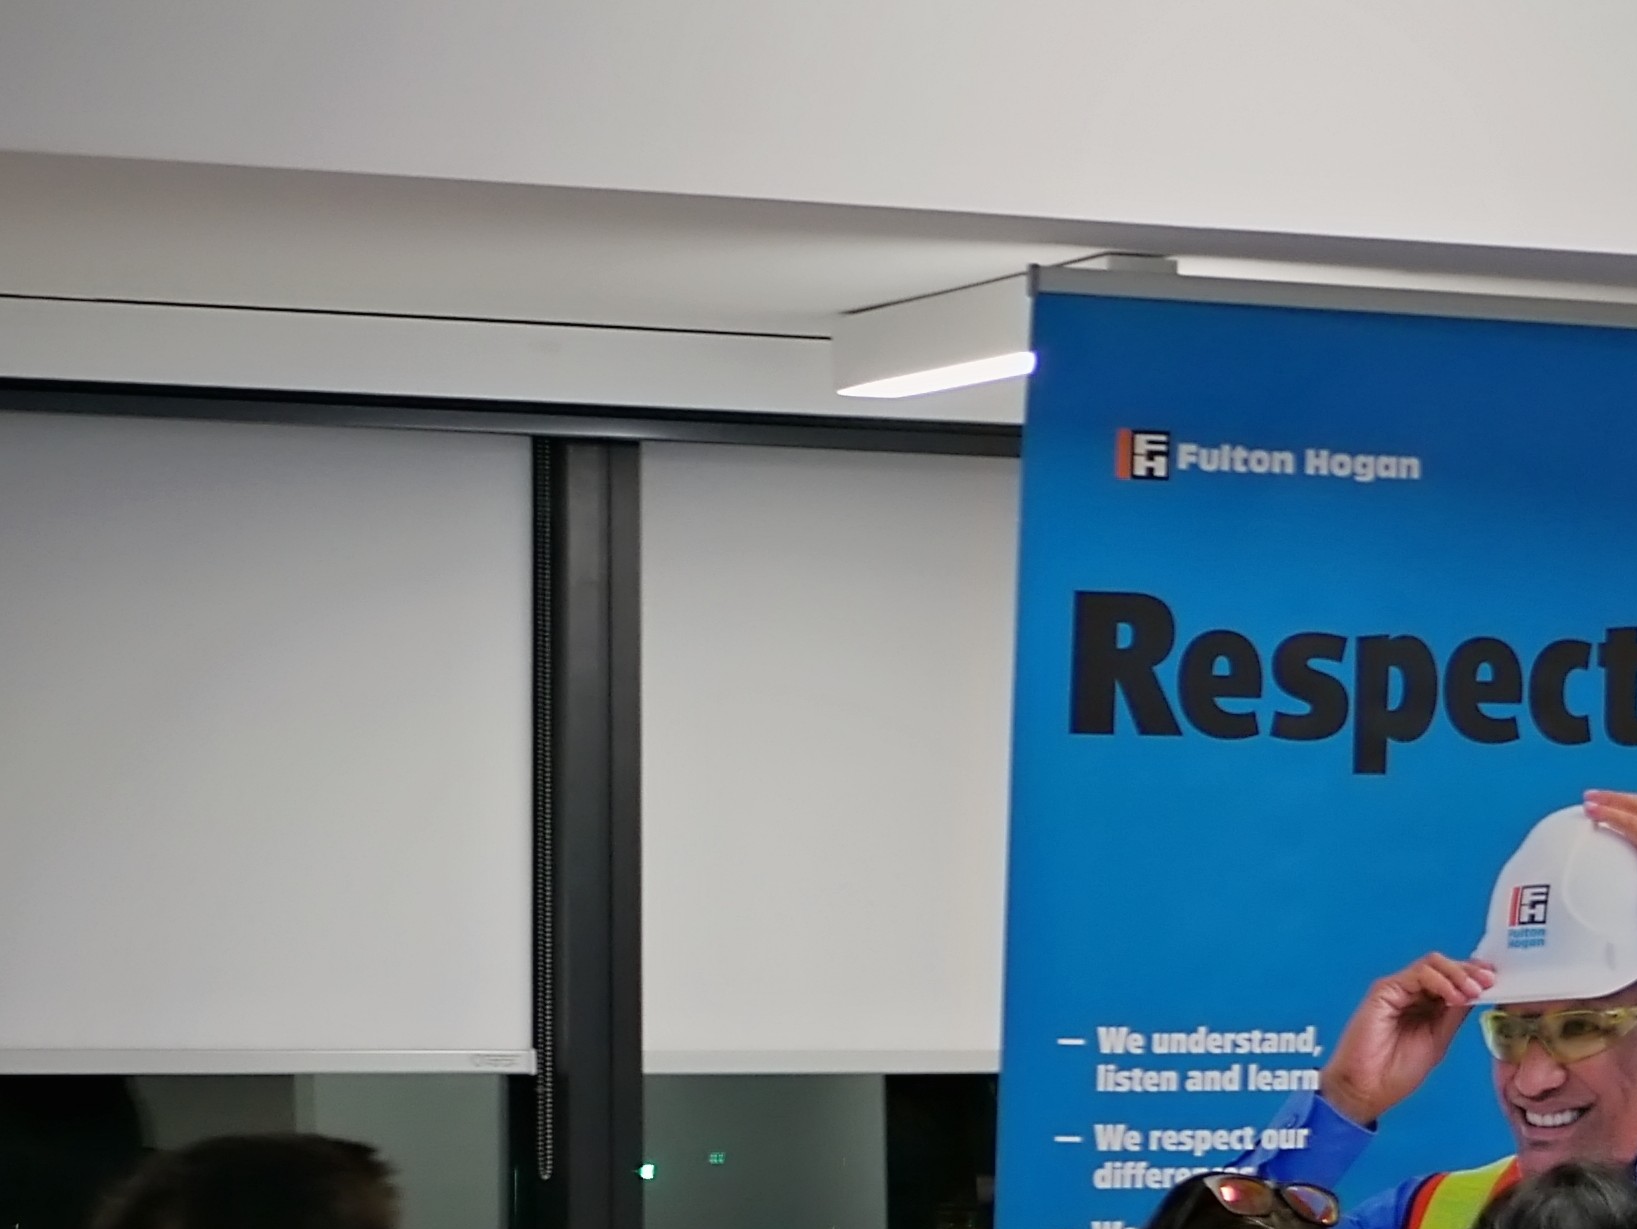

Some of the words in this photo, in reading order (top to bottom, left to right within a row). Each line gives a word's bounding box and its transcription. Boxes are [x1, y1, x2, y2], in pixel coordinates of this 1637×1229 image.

[1176, 443, 1295, 474] Fulton
[1305, 449, 1421, 482] Hogan
[1097, 1027, 1144, 1054] We
[1152, 1025, 1322, 1056] understand,
[1096, 1064, 1178, 1092] listen
[1185, 1064, 1240, 1092] and
[1248, 1064, 1320, 1091] learn
[1094, 1124, 1141, 1151] We
[1149, 1126, 1254, 1157] respect
[1261, 1128, 1309, 1150] our
